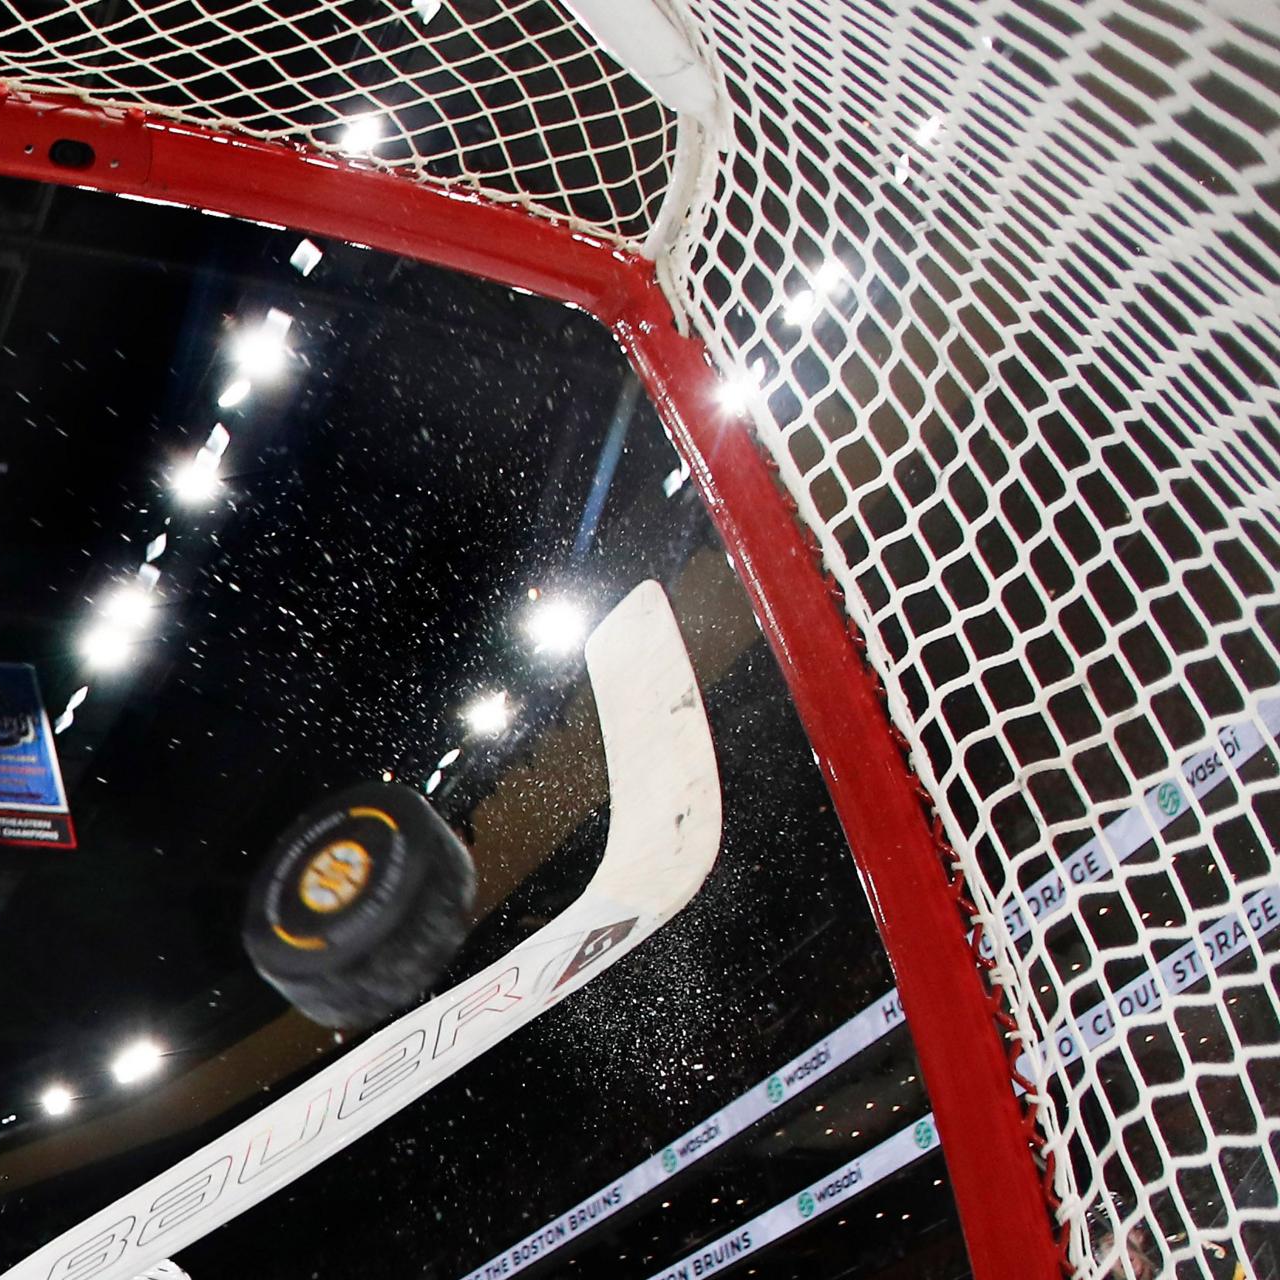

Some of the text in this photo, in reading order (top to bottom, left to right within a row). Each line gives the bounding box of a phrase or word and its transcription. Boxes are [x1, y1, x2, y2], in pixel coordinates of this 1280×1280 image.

[510, 1221, 566, 1267] BOSTON
[677, 1118, 722, 1158] wasabi
[783, 1042, 833, 1088] wasabi
[693, 1231, 754, 1278] BRUINS
[814, 1162, 864, 1203] wasabi
